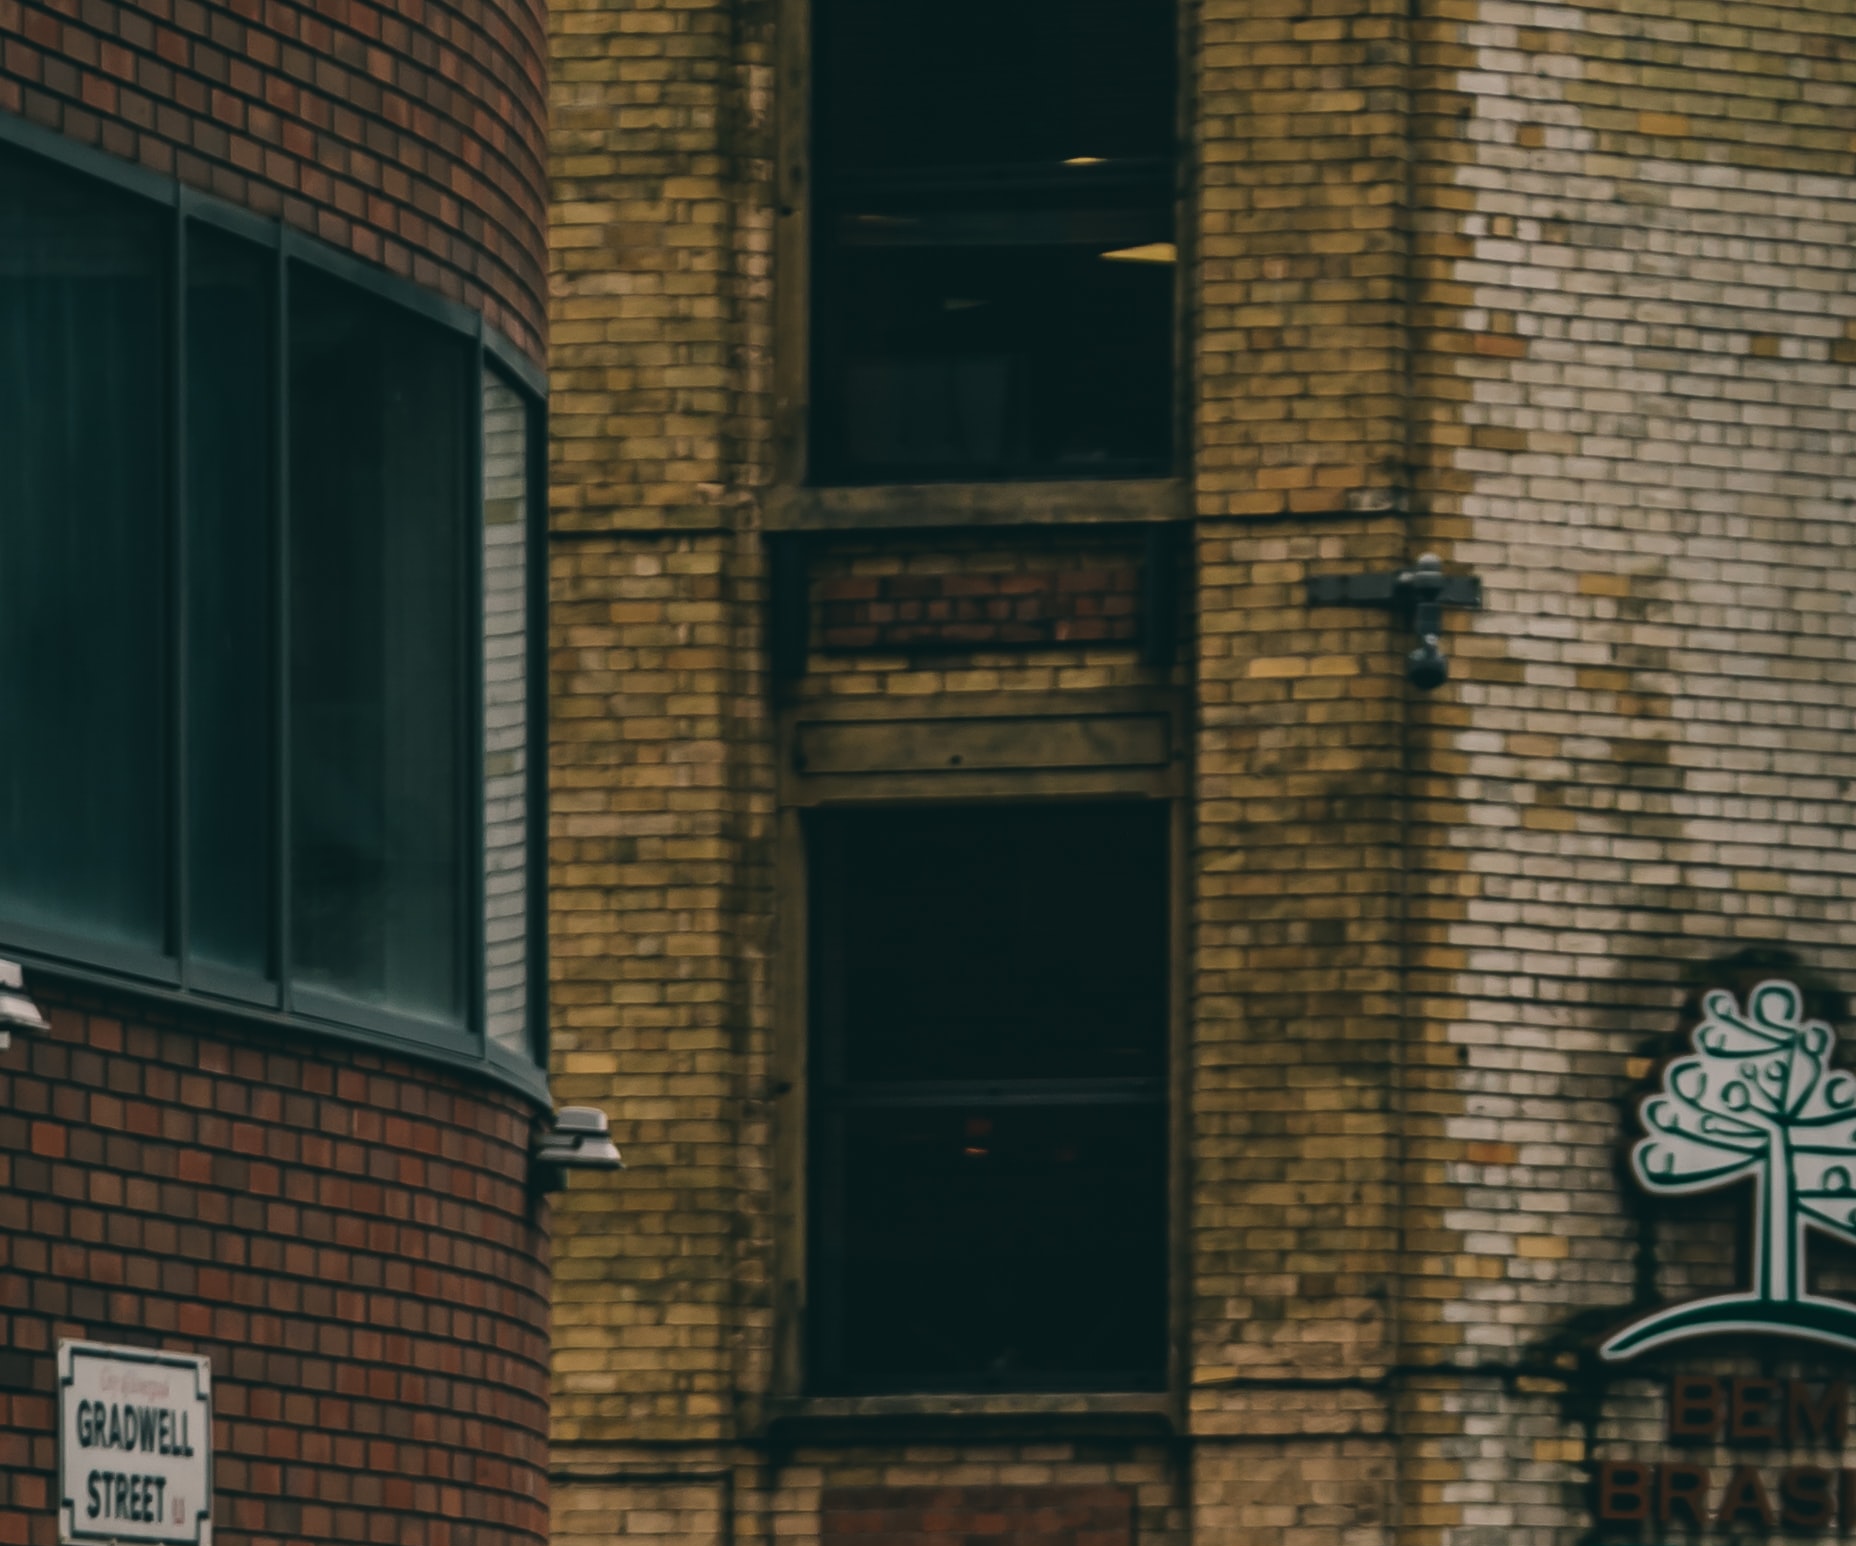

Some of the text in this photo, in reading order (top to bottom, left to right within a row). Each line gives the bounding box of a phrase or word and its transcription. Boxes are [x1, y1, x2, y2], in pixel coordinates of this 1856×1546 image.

[77, 1399, 194, 1457] GRADWELL
[1671, 1375, 1849, 1445] BEM
[87, 1469, 166, 1524] STREET
